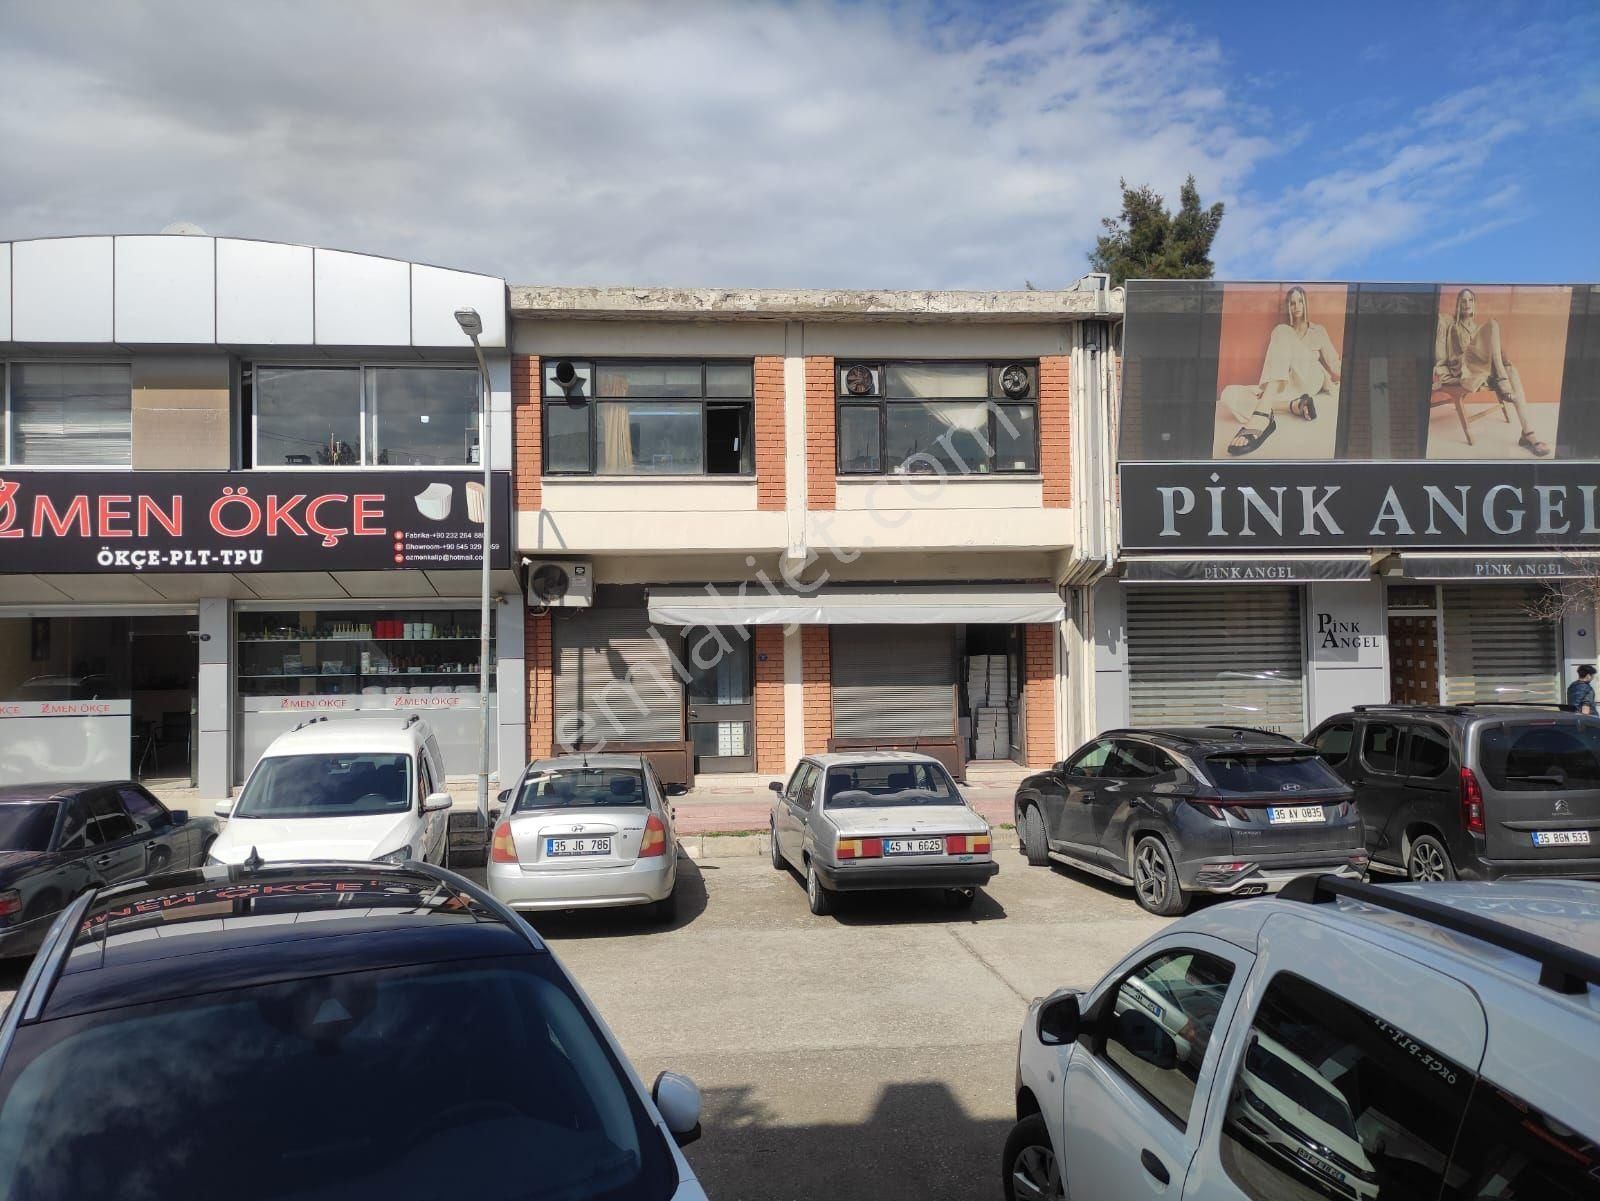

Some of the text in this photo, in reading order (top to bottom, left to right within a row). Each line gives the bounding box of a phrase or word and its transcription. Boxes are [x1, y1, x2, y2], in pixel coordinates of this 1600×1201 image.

[1156, 472, 1600, 537] PİNK ANGEL
[209, 486, 387, 547] ÖKÇE
[97, 546, 264, 569] ÖKÇE-PLT-TPU
[405, 554, 485, 562] ozmenkalip@hotmail.co
[1243, 567, 1297, 579] ANGEL
[1515, 563, 1565, 575] ANGEL
[1321, 628, 1380, 648] ANGEL
[1274, 807, 1322, 820] 35 AV 0835
[1538, 833, 1550, 844] 35
[1571, 832, 1589, 842] 533
[554, 839, 609, 852] 35 JG 786
[889, 841, 941, 852] 45 N 6625
